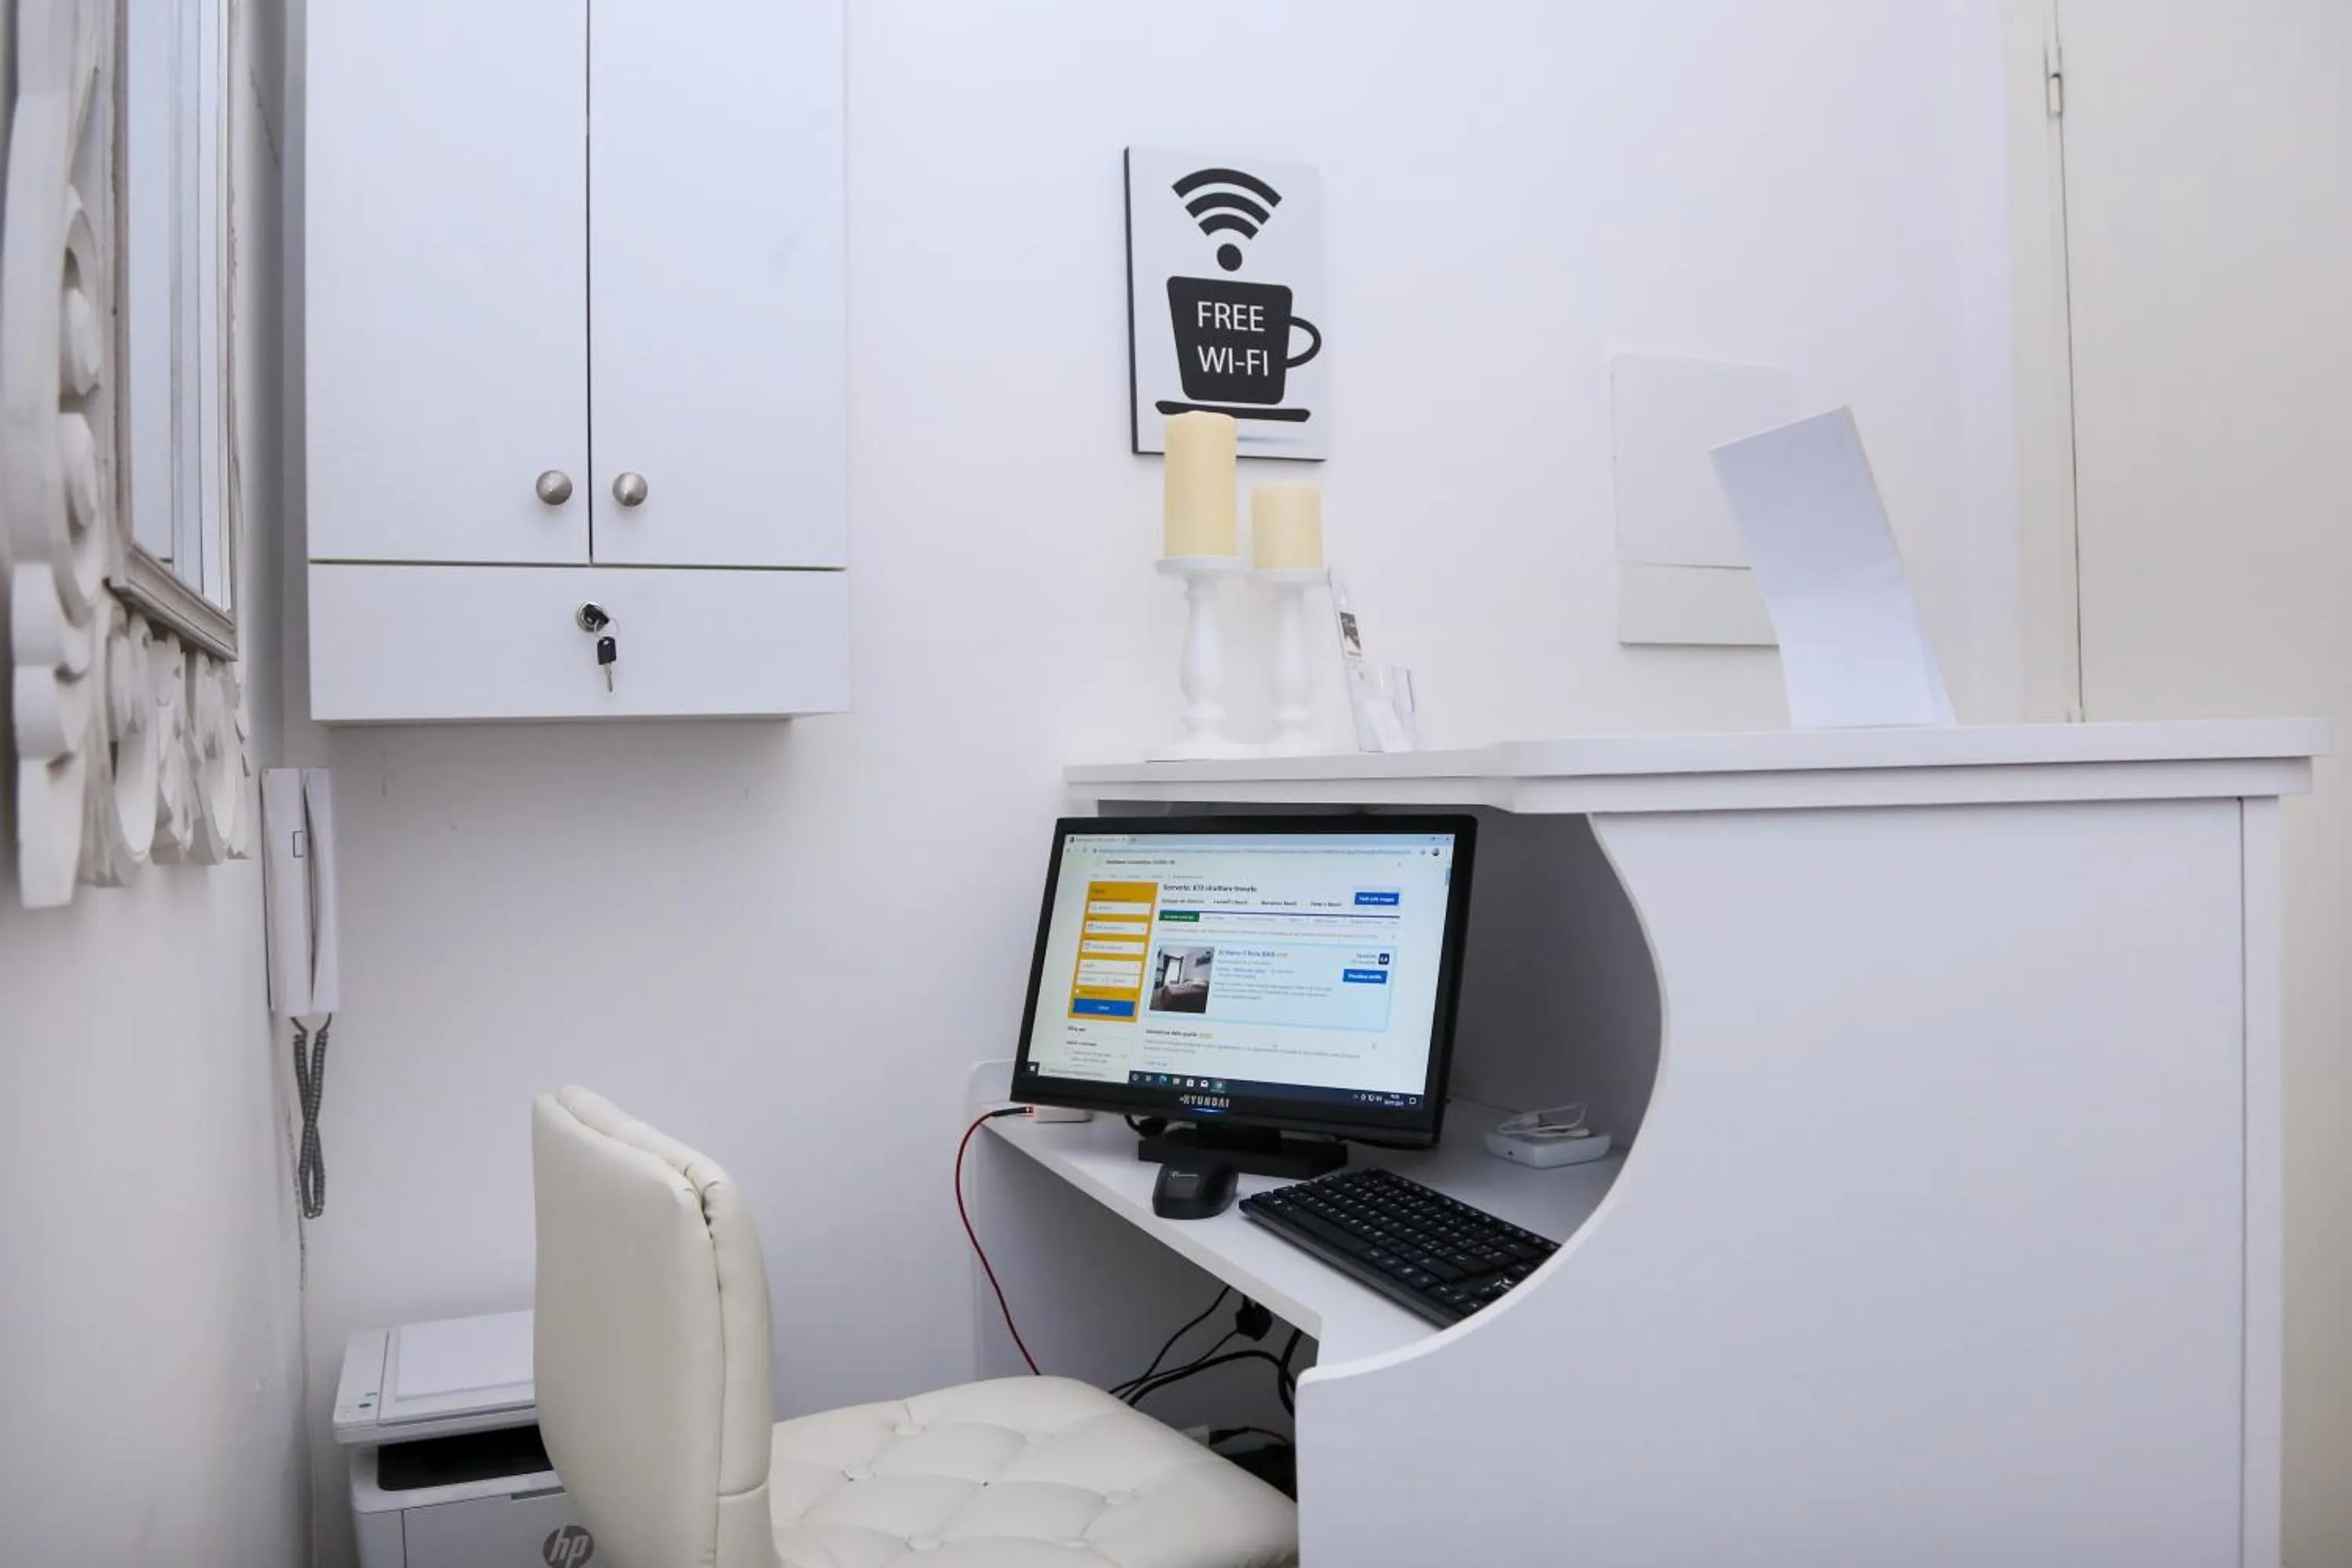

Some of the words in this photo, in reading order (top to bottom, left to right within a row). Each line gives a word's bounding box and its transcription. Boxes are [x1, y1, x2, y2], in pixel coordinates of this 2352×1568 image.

[1197, 300, 1265, 332] FREE
[1197, 345, 1269, 376] WI-FI
[1179, 1094, 1229, 1108] HYUNDAI
[549, 1526, 590, 1568] hp
